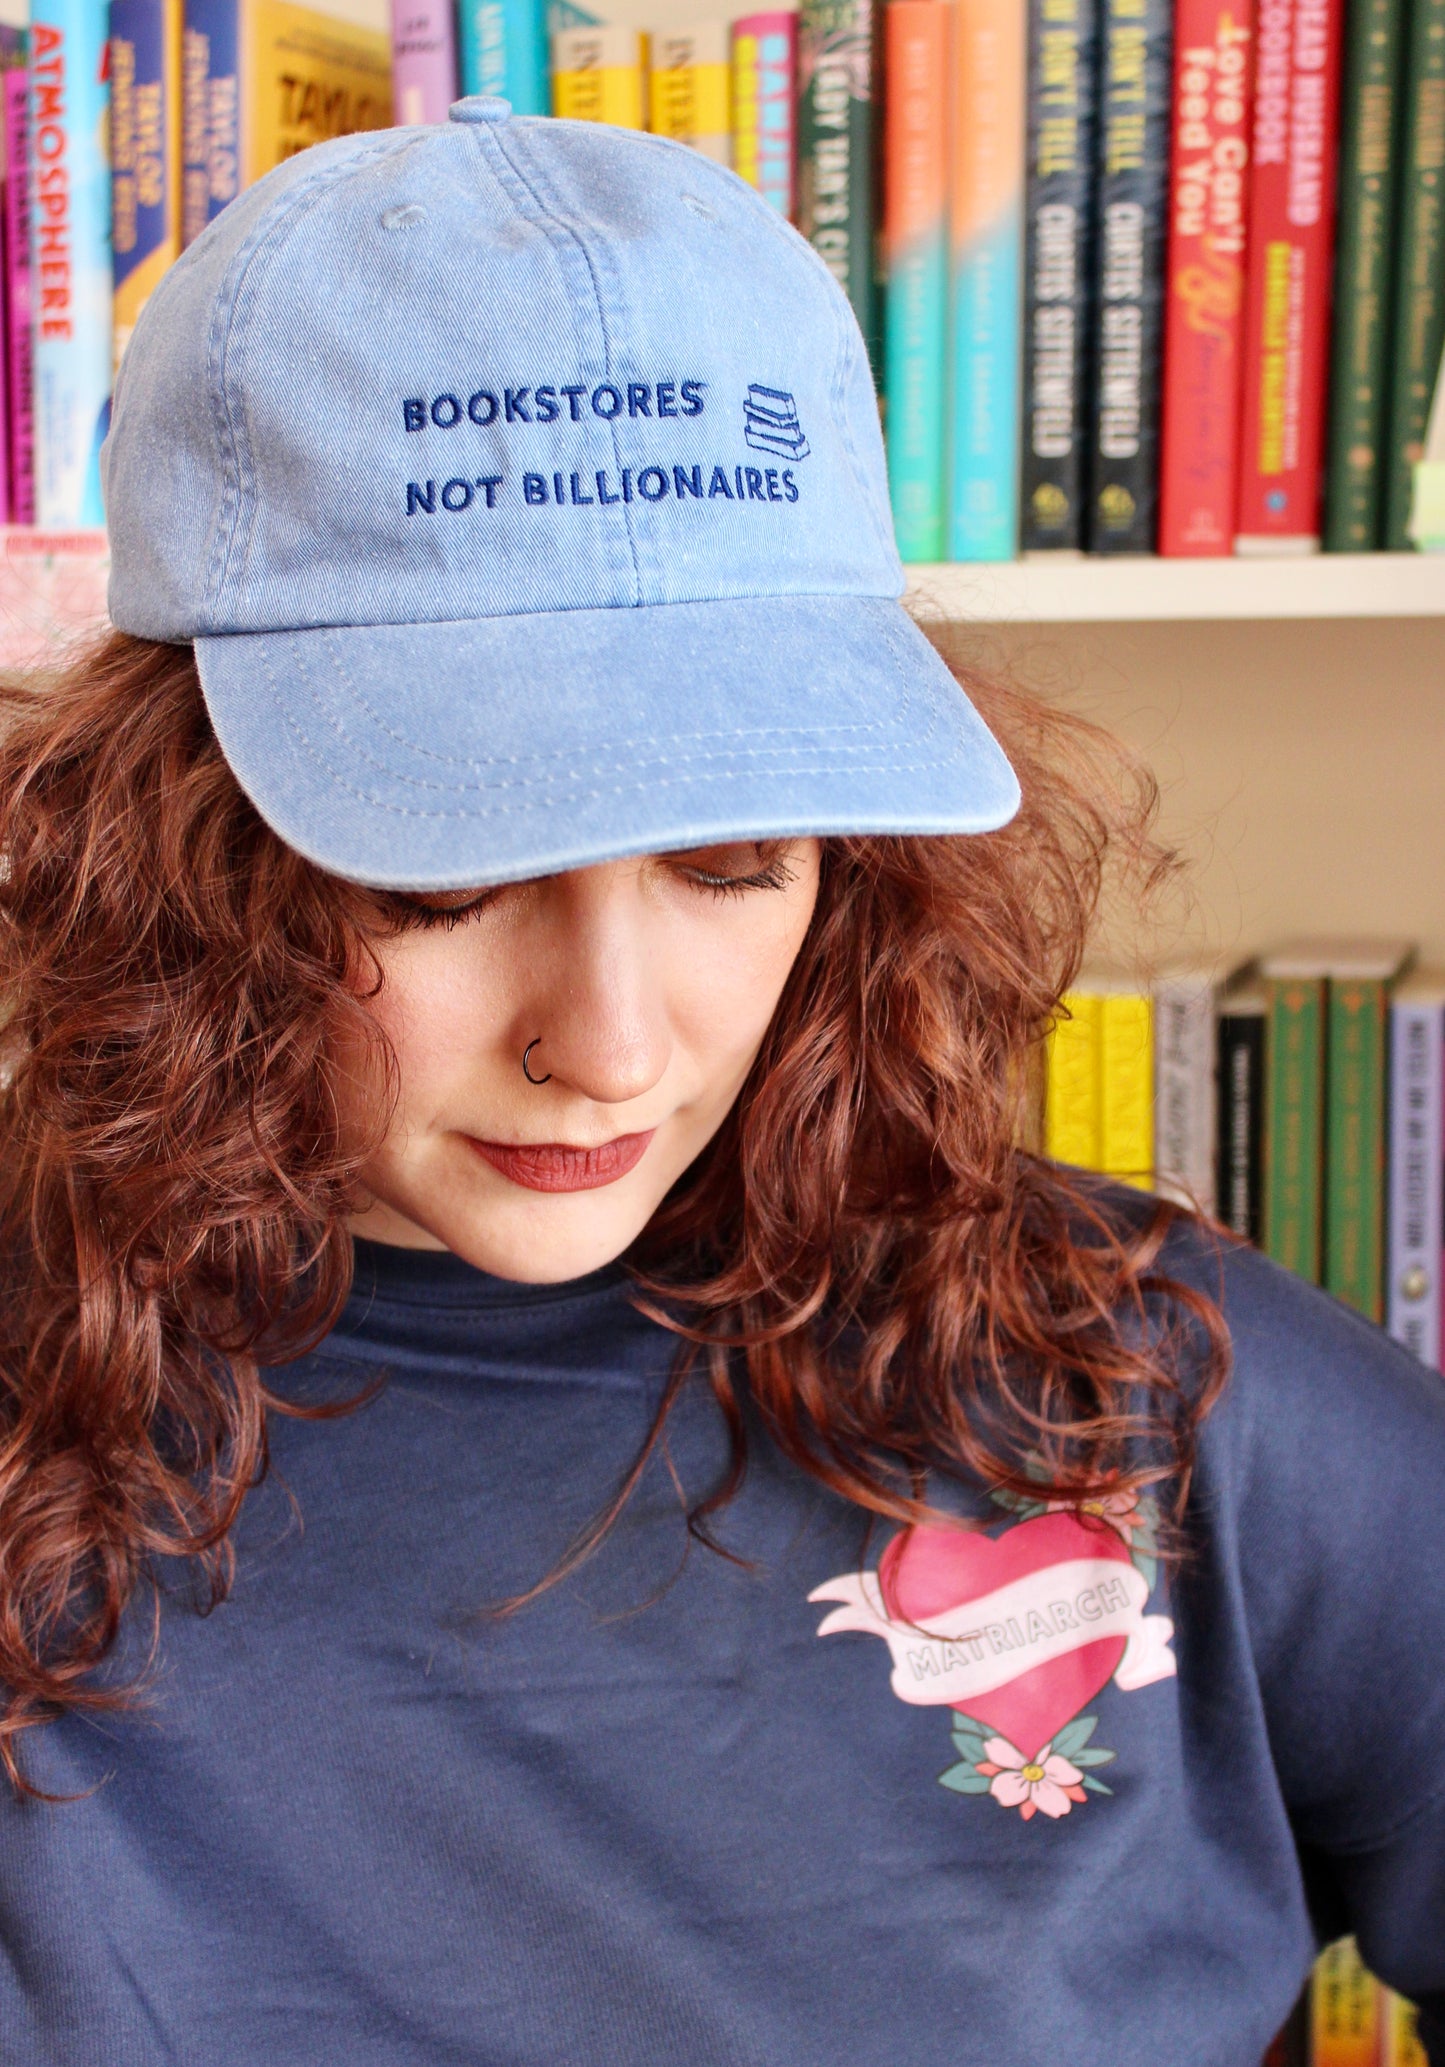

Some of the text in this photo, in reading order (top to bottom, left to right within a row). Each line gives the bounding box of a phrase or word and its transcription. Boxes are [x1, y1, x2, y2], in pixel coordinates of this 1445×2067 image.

[1040, 28, 1079, 106] DON'T
[1108, 26, 1147, 104] DON'T
[31, 23, 74, 342] ATMOSPHERE
[1037, 115, 1077, 176] TELL
[1105, 113, 1145, 174] TELL
[1175, 46, 1217, 237] Feed You
[1211, 20, 1249, 255] Love Can't
[1286, 72, 1326, 227] HUSBAND
[1035, 203, 1077, 300] CURTIS
[1103, 201, 1145, 300] CURTIS
[402, 380, 709, 433] BOOKSTORES
[404, 464, 800, 517] NOT BILLIONAIRES
[906, 1576, 1132, 1682] MATRIARCH
